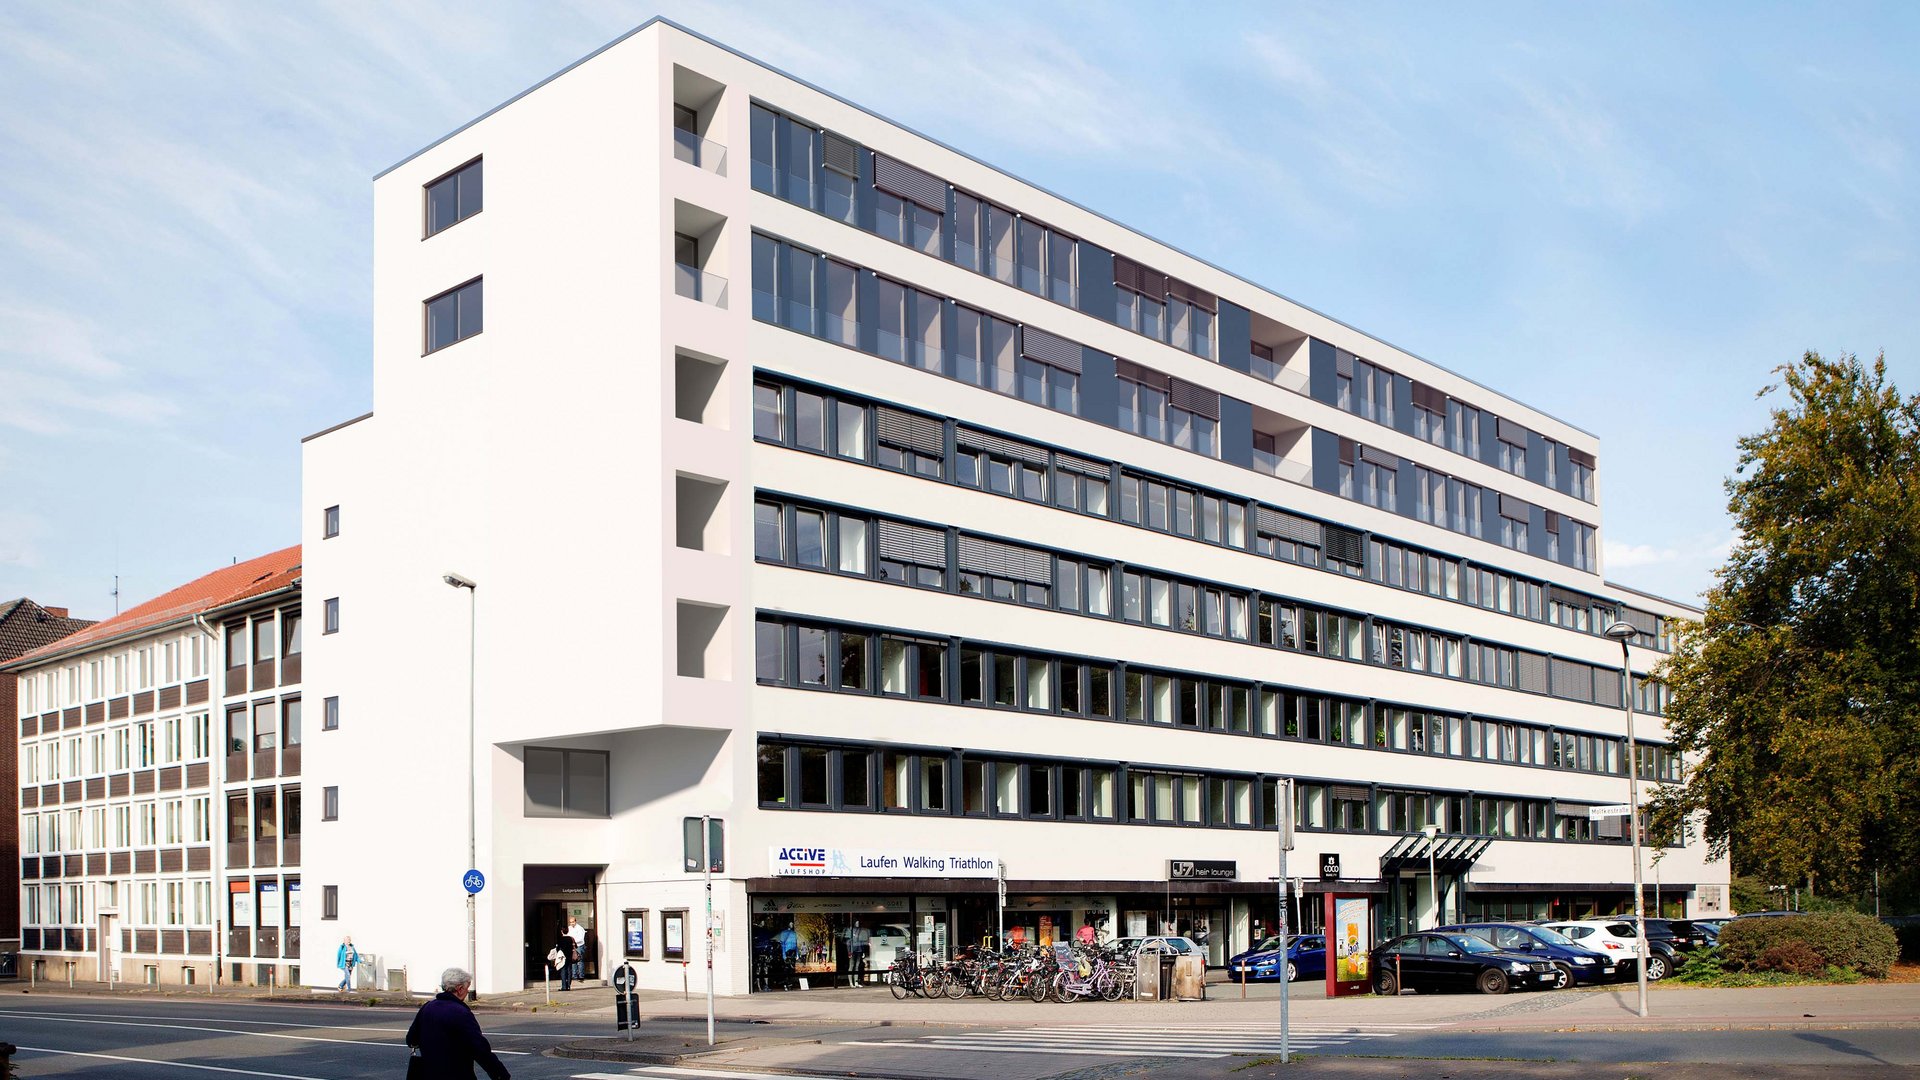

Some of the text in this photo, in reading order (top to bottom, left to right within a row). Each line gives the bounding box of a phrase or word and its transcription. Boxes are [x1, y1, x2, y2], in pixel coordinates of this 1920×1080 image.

[860, 856, 993, 871] Laufen Walking Triathlon
[1195, 868, 1210, 876] hair
[1211, 868, 1234, 877] lounge
[1323, 865, 1339, 873] COCO
